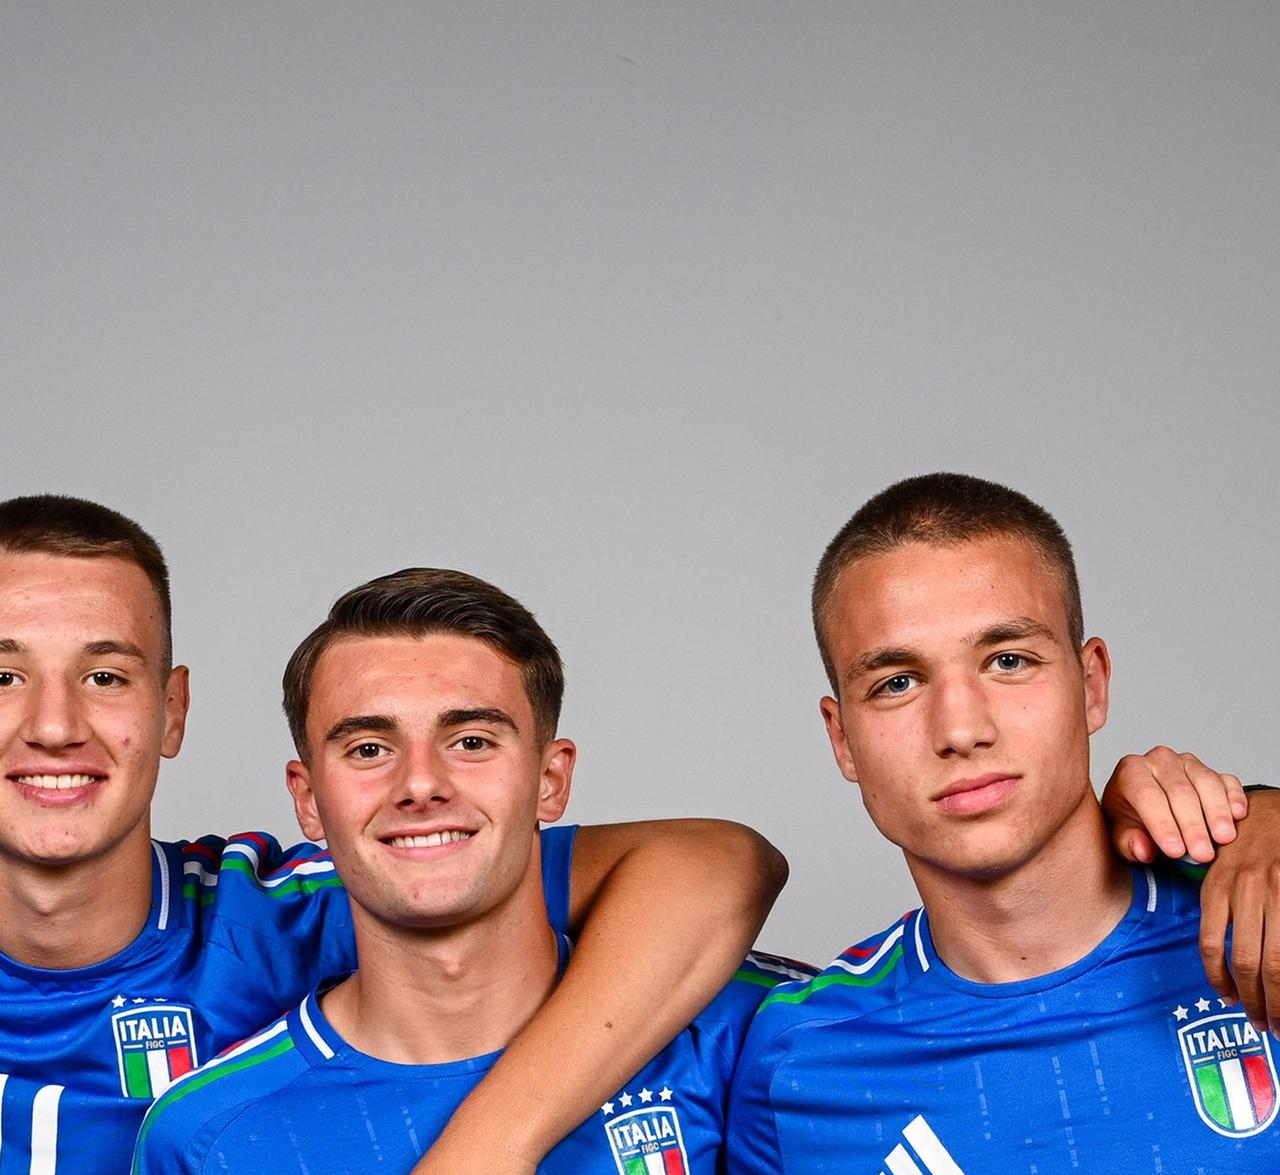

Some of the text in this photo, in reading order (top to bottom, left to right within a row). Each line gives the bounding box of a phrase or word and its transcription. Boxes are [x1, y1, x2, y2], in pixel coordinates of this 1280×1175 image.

[119, 1015, 188, 1042] ITALIA
[1186, 1021, 1260, 1056] ITALIA
[145, 1039, 166, 1050] FIGC
[1217, 1048, 1238, 1060] FIGC
[612, 1115, 675, 1150] ITALIA
[641, 1141, 660, 1154] FIGC
